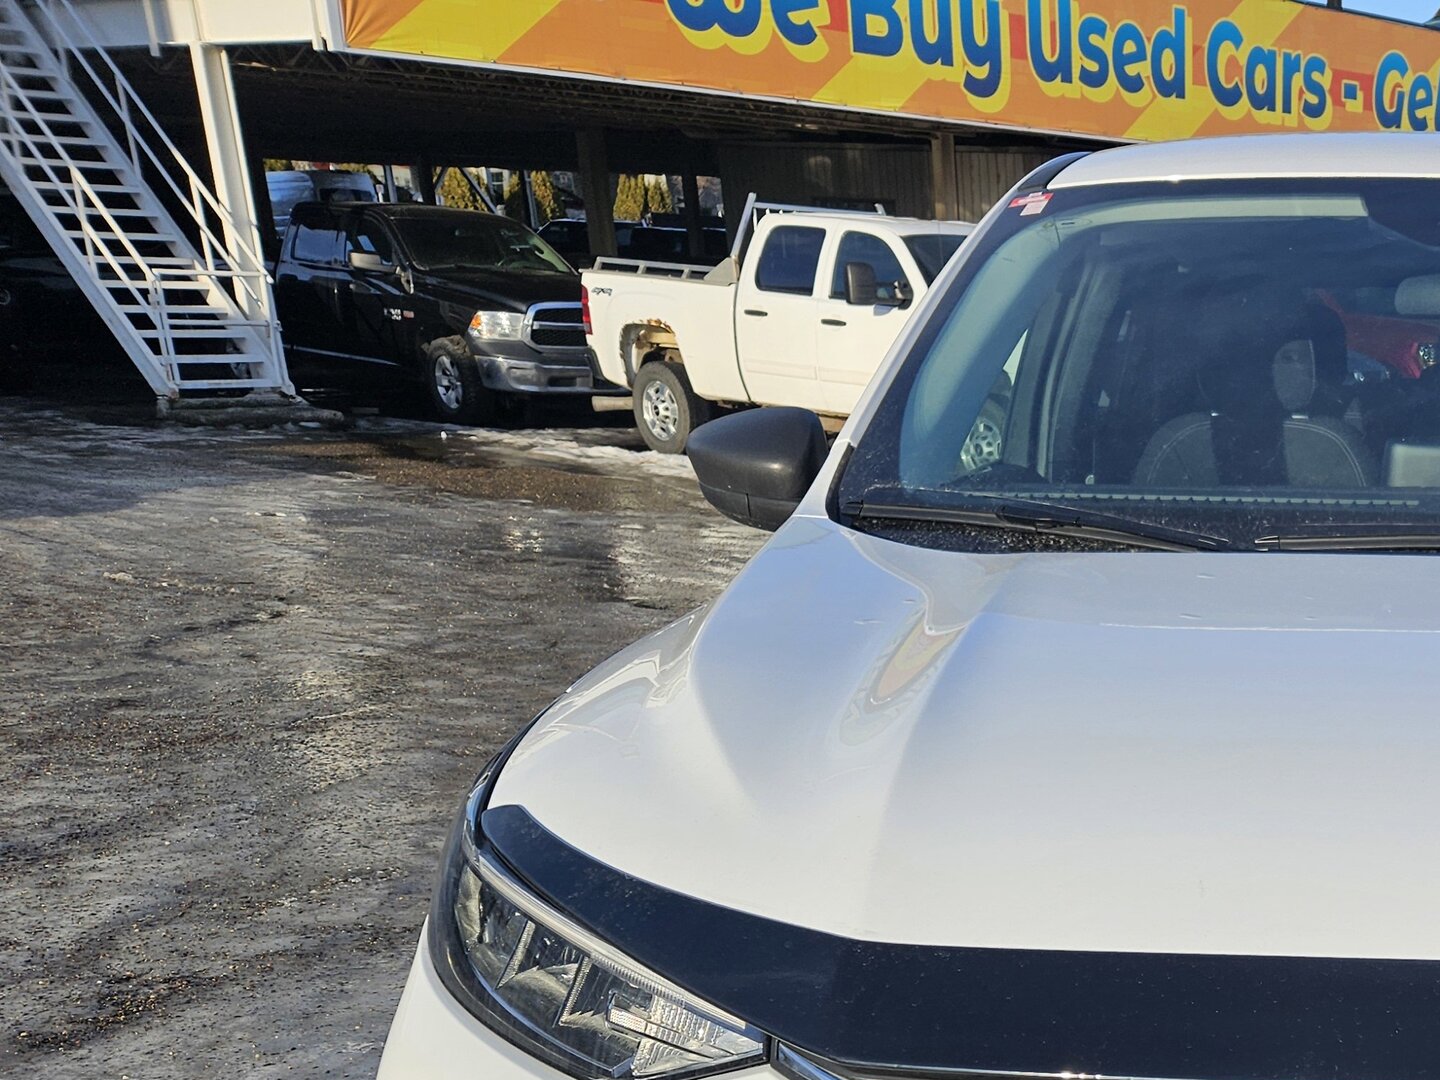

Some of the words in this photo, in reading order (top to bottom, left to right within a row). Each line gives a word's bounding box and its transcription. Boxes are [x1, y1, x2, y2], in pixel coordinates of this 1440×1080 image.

[851, 0, 1001, 98] Buy
[1026, 0, 1188, 100] Used
[1206, 19, 1328, 119] Cars
